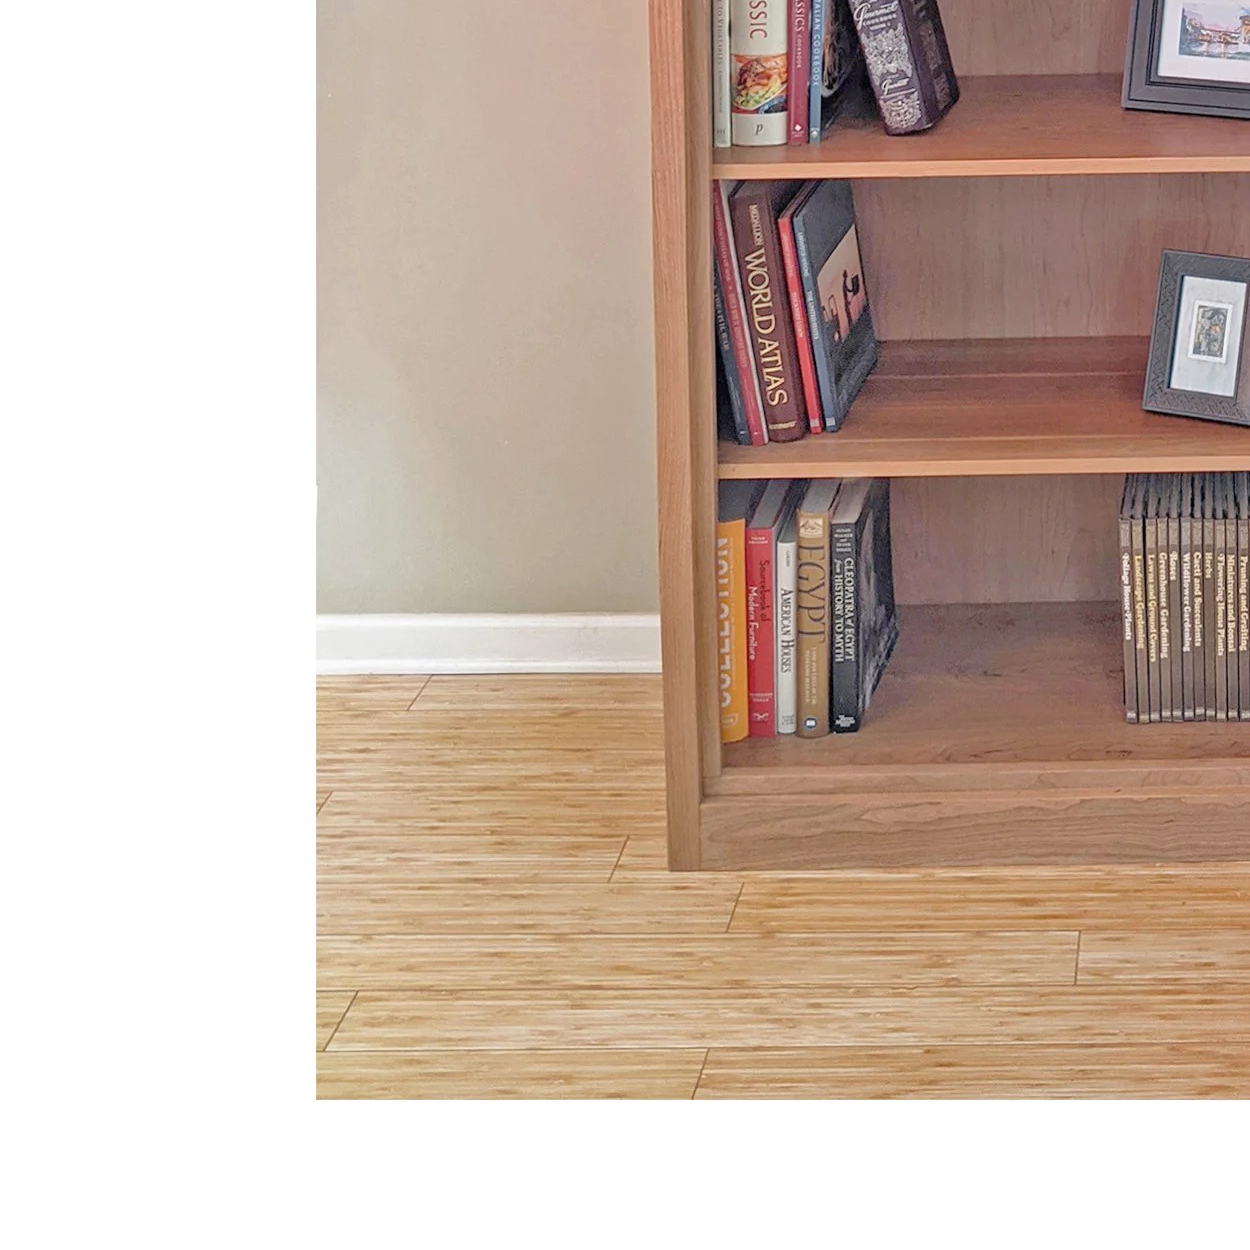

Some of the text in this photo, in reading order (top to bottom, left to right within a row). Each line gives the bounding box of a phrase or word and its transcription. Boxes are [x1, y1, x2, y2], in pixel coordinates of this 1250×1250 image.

[812, 34, 820, 87] COOKBOOK
[749, 205, 763, 246] MEDALLION
[745, 247, 775, 334] WORLD
[757, 337, 788, 406] ATLAS
[759, 560, 771, 621] Sourcebook of
[798, 545, 826, 644] EGYPT
[844, 558, 855, 618] CLEOPATRA
[1121, 553, 1131, 585] Foliage
[1134, 555, 1145, 649] Landscape Gardening
[1159, 552, 1169, 658] Greenhouse Gardening
[1169, 551, 1178, 580] Roses
[1182, 553, 1191, 652] Wildflower Gardening
[1194, 551, 1202, 646] Cacti and Succulents
[1205, 552, 1213, 578] Herbs
[1216, 553, 1225, 656] Flowering House Plants
[1227, 554, 1236, 652] Miniatures and Bonsai
[1239, 556, 1249, 650] Pruning and Grafting
[748, 587, 760, 661] Modern Furniture
[781, 588, 795, 673] AMERICAN HOUSES
[833, 559, 844, 662] from HISTORY TO MYTH
[845, 628, 854, 661] EGYPT
[1124, 611, 1132, 640] Plants
[1147, 554, 1157, 662] Lawns and Ground Covers
